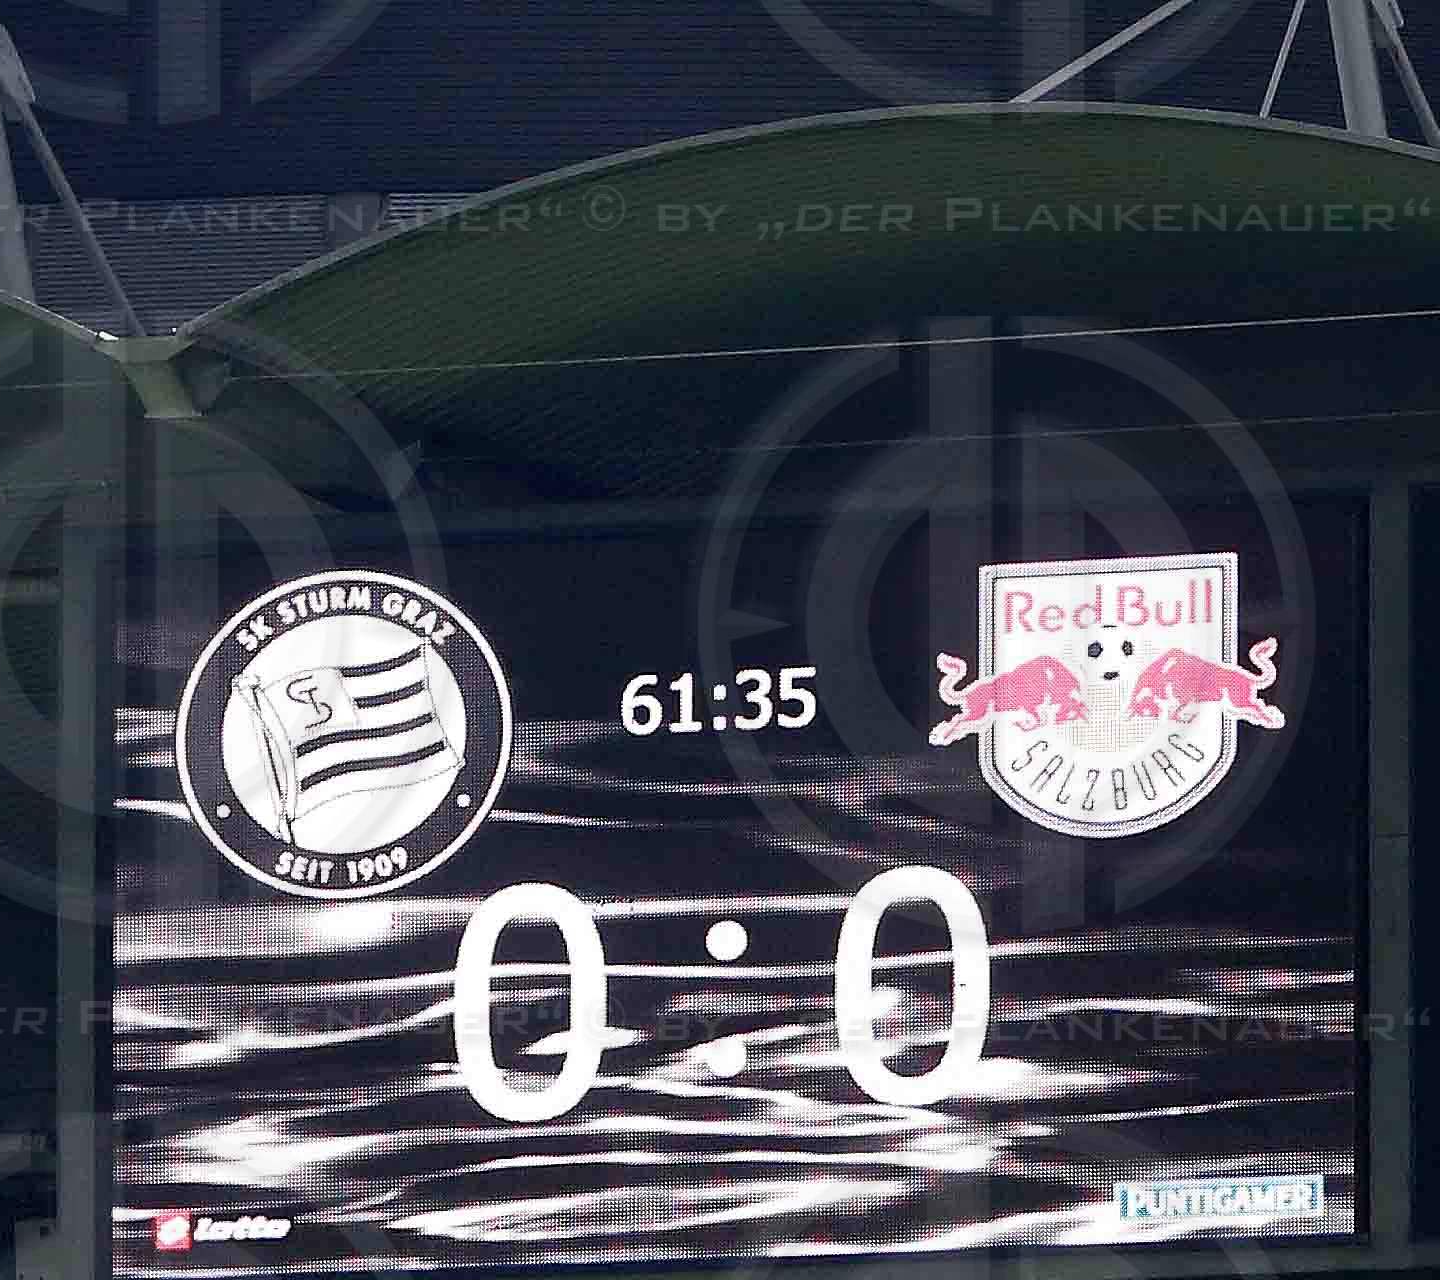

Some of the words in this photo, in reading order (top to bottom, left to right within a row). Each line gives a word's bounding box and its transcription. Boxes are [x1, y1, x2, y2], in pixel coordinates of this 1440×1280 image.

[236, 614, 274, 652] SK
[276, 586, 372, 626] STURM
[382, 591, 457, 646] GRAZ
[1003, 583, 1105, 634] Red
[1116, 577, 1214, 627] Bull
[620, 666, 818, 738] 61:35
[1011, 733, 1205, 812] SALZBURG
[274, 851, 334, 884] SEIT
[346, 846, 409, 884] 1909
[453, 881, 606, 1122] 0
[833, 865, 991, 1106] 0
